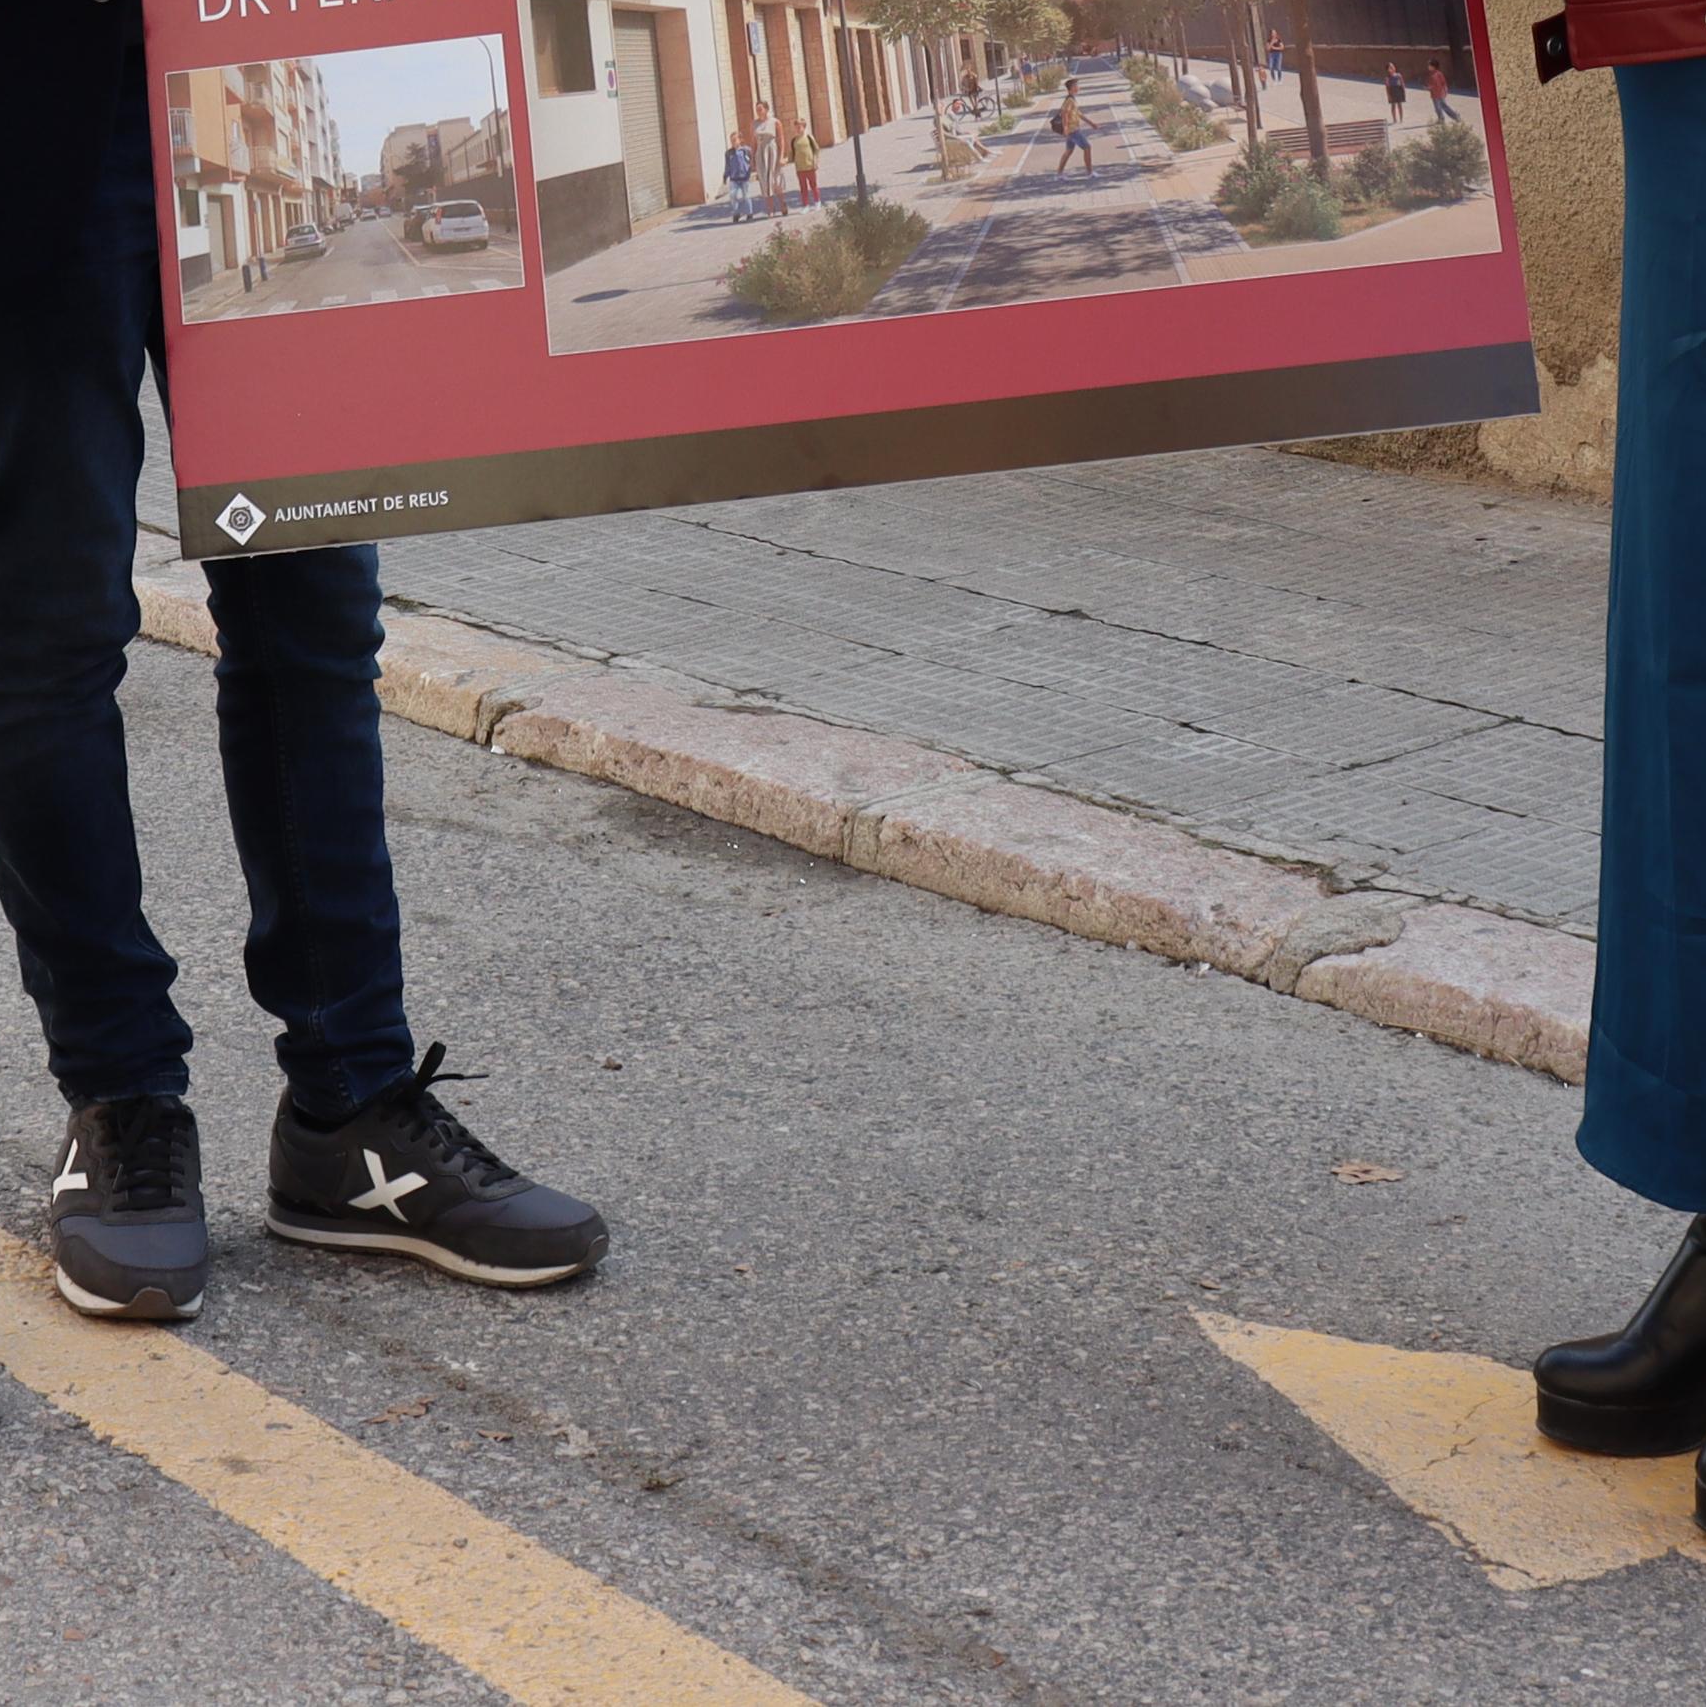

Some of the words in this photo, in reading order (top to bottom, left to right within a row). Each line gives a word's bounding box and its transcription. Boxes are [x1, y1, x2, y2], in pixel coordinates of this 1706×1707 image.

[274, 497, 378, 523] AJUNTAMENT
[383, 495, 405, 511] DE
[408, 490, 449, 509] REUS
